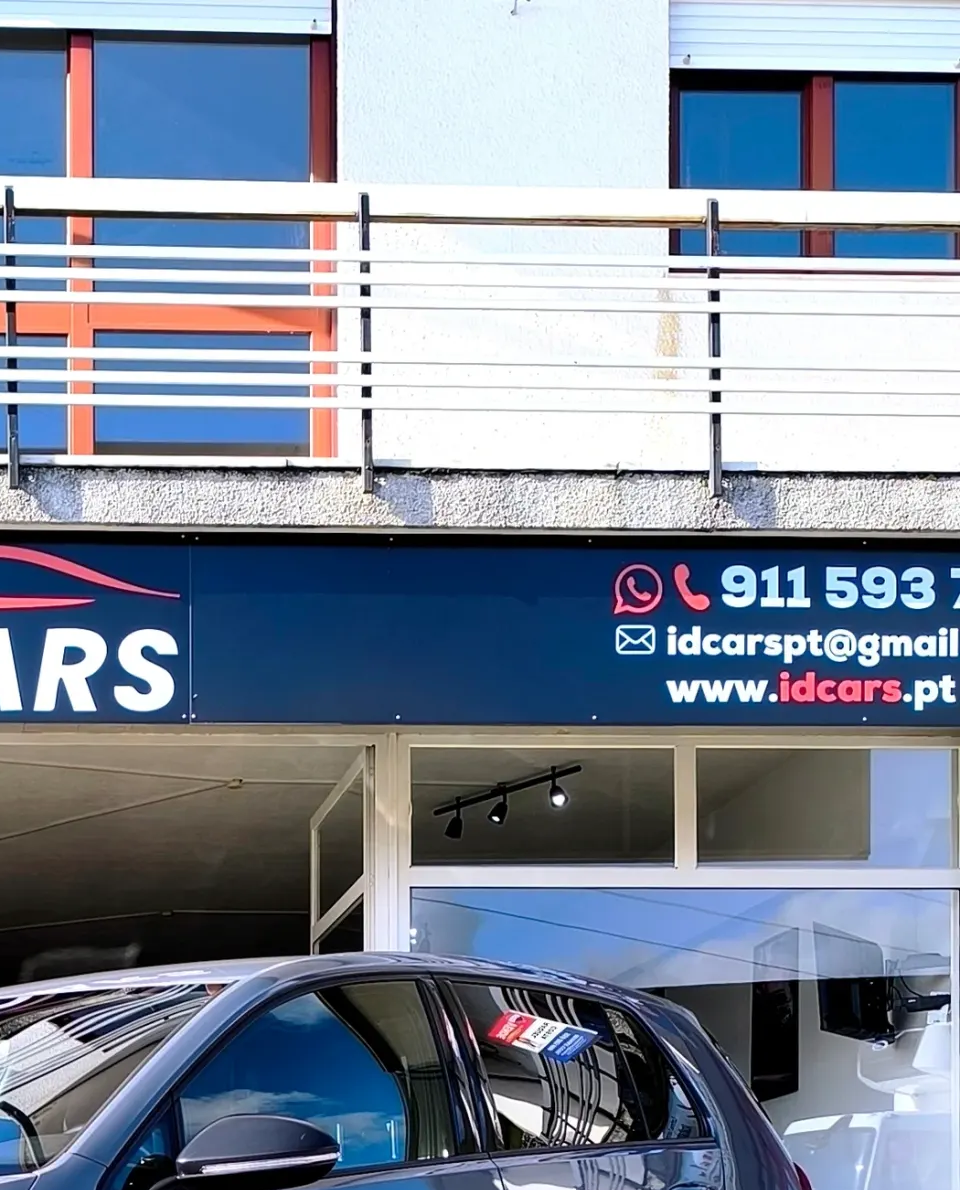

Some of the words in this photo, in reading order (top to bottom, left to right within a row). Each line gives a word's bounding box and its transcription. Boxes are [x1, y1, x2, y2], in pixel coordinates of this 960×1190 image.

[721, 565, 811, 608] 911
[825, 566, 936, 610] 593
[666, 625, 959, 667] idcarspt@gmail
[666, 671, 957, 711] www.idcars.pt
